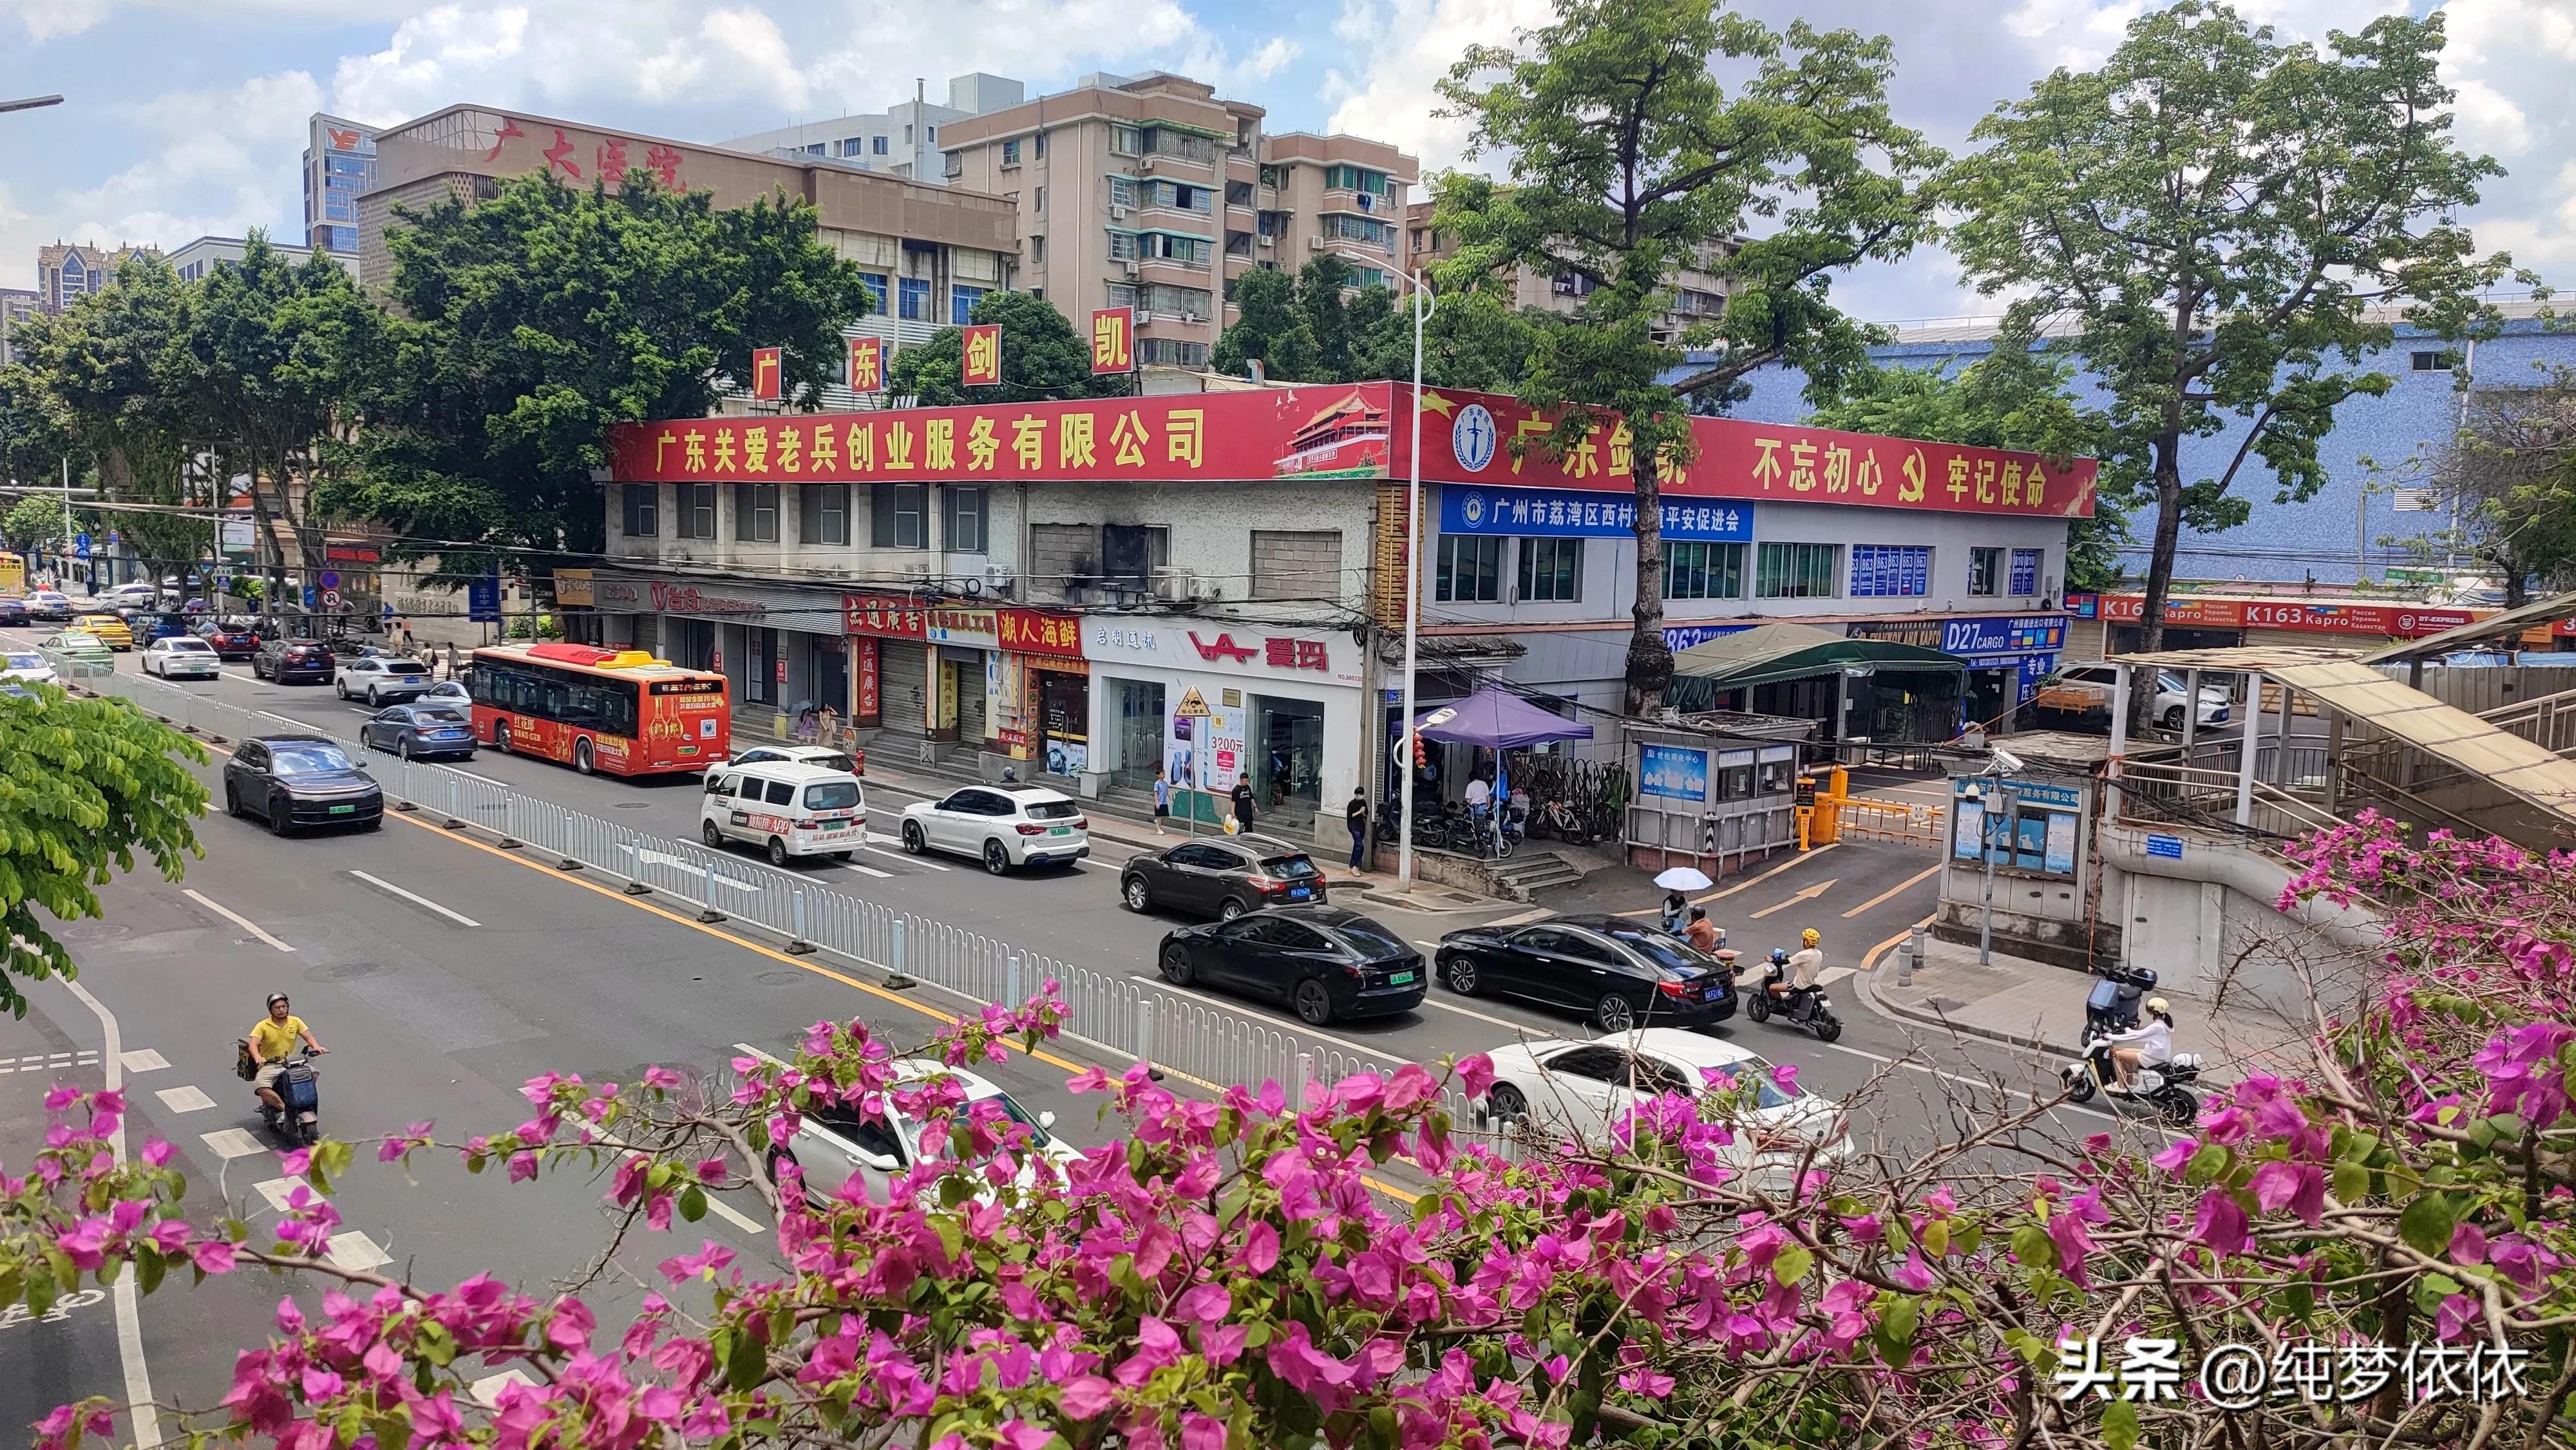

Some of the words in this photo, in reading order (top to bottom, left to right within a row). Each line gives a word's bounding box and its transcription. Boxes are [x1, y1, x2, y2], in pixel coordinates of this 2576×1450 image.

[485, 120, 687, 194] 广大医院
[656, 409, 1204, 475] 广东关爱老兵创业服务有限公司
[1752, 438, 1883, 496] 不忘初心
[1946, 454, 2047, 508] 牢记使命
[1492, 497, 1740, 533] 广州市荔湾区西村平安促进会
[1862, 558, 1873, 571] 863
[1877, 557, 1888, 569] 863
[1916, 556, 1926, 568] 863
[2104, 601, 2145, 616] K16
[2246, 606, 2302, 623] K163
[2306, 614, 2349, 627] Карго
[2418, 616, 2465, 624] DT-EXPRESS
[1001, 613, 1077, 649] 潮人海鲜
[1095, 626, 1157, 650] 启明通讯
[1946, 623, 1981, 650] D27
[1976, 636, 2004, 649] CARGO
[1265, 637, 1329, 672] 爱玛
[2028, 657, 2045, 676] 专业
[513, 715, 535, 731] 红花郎
[1211, 736, 1244, 753] 3200元
